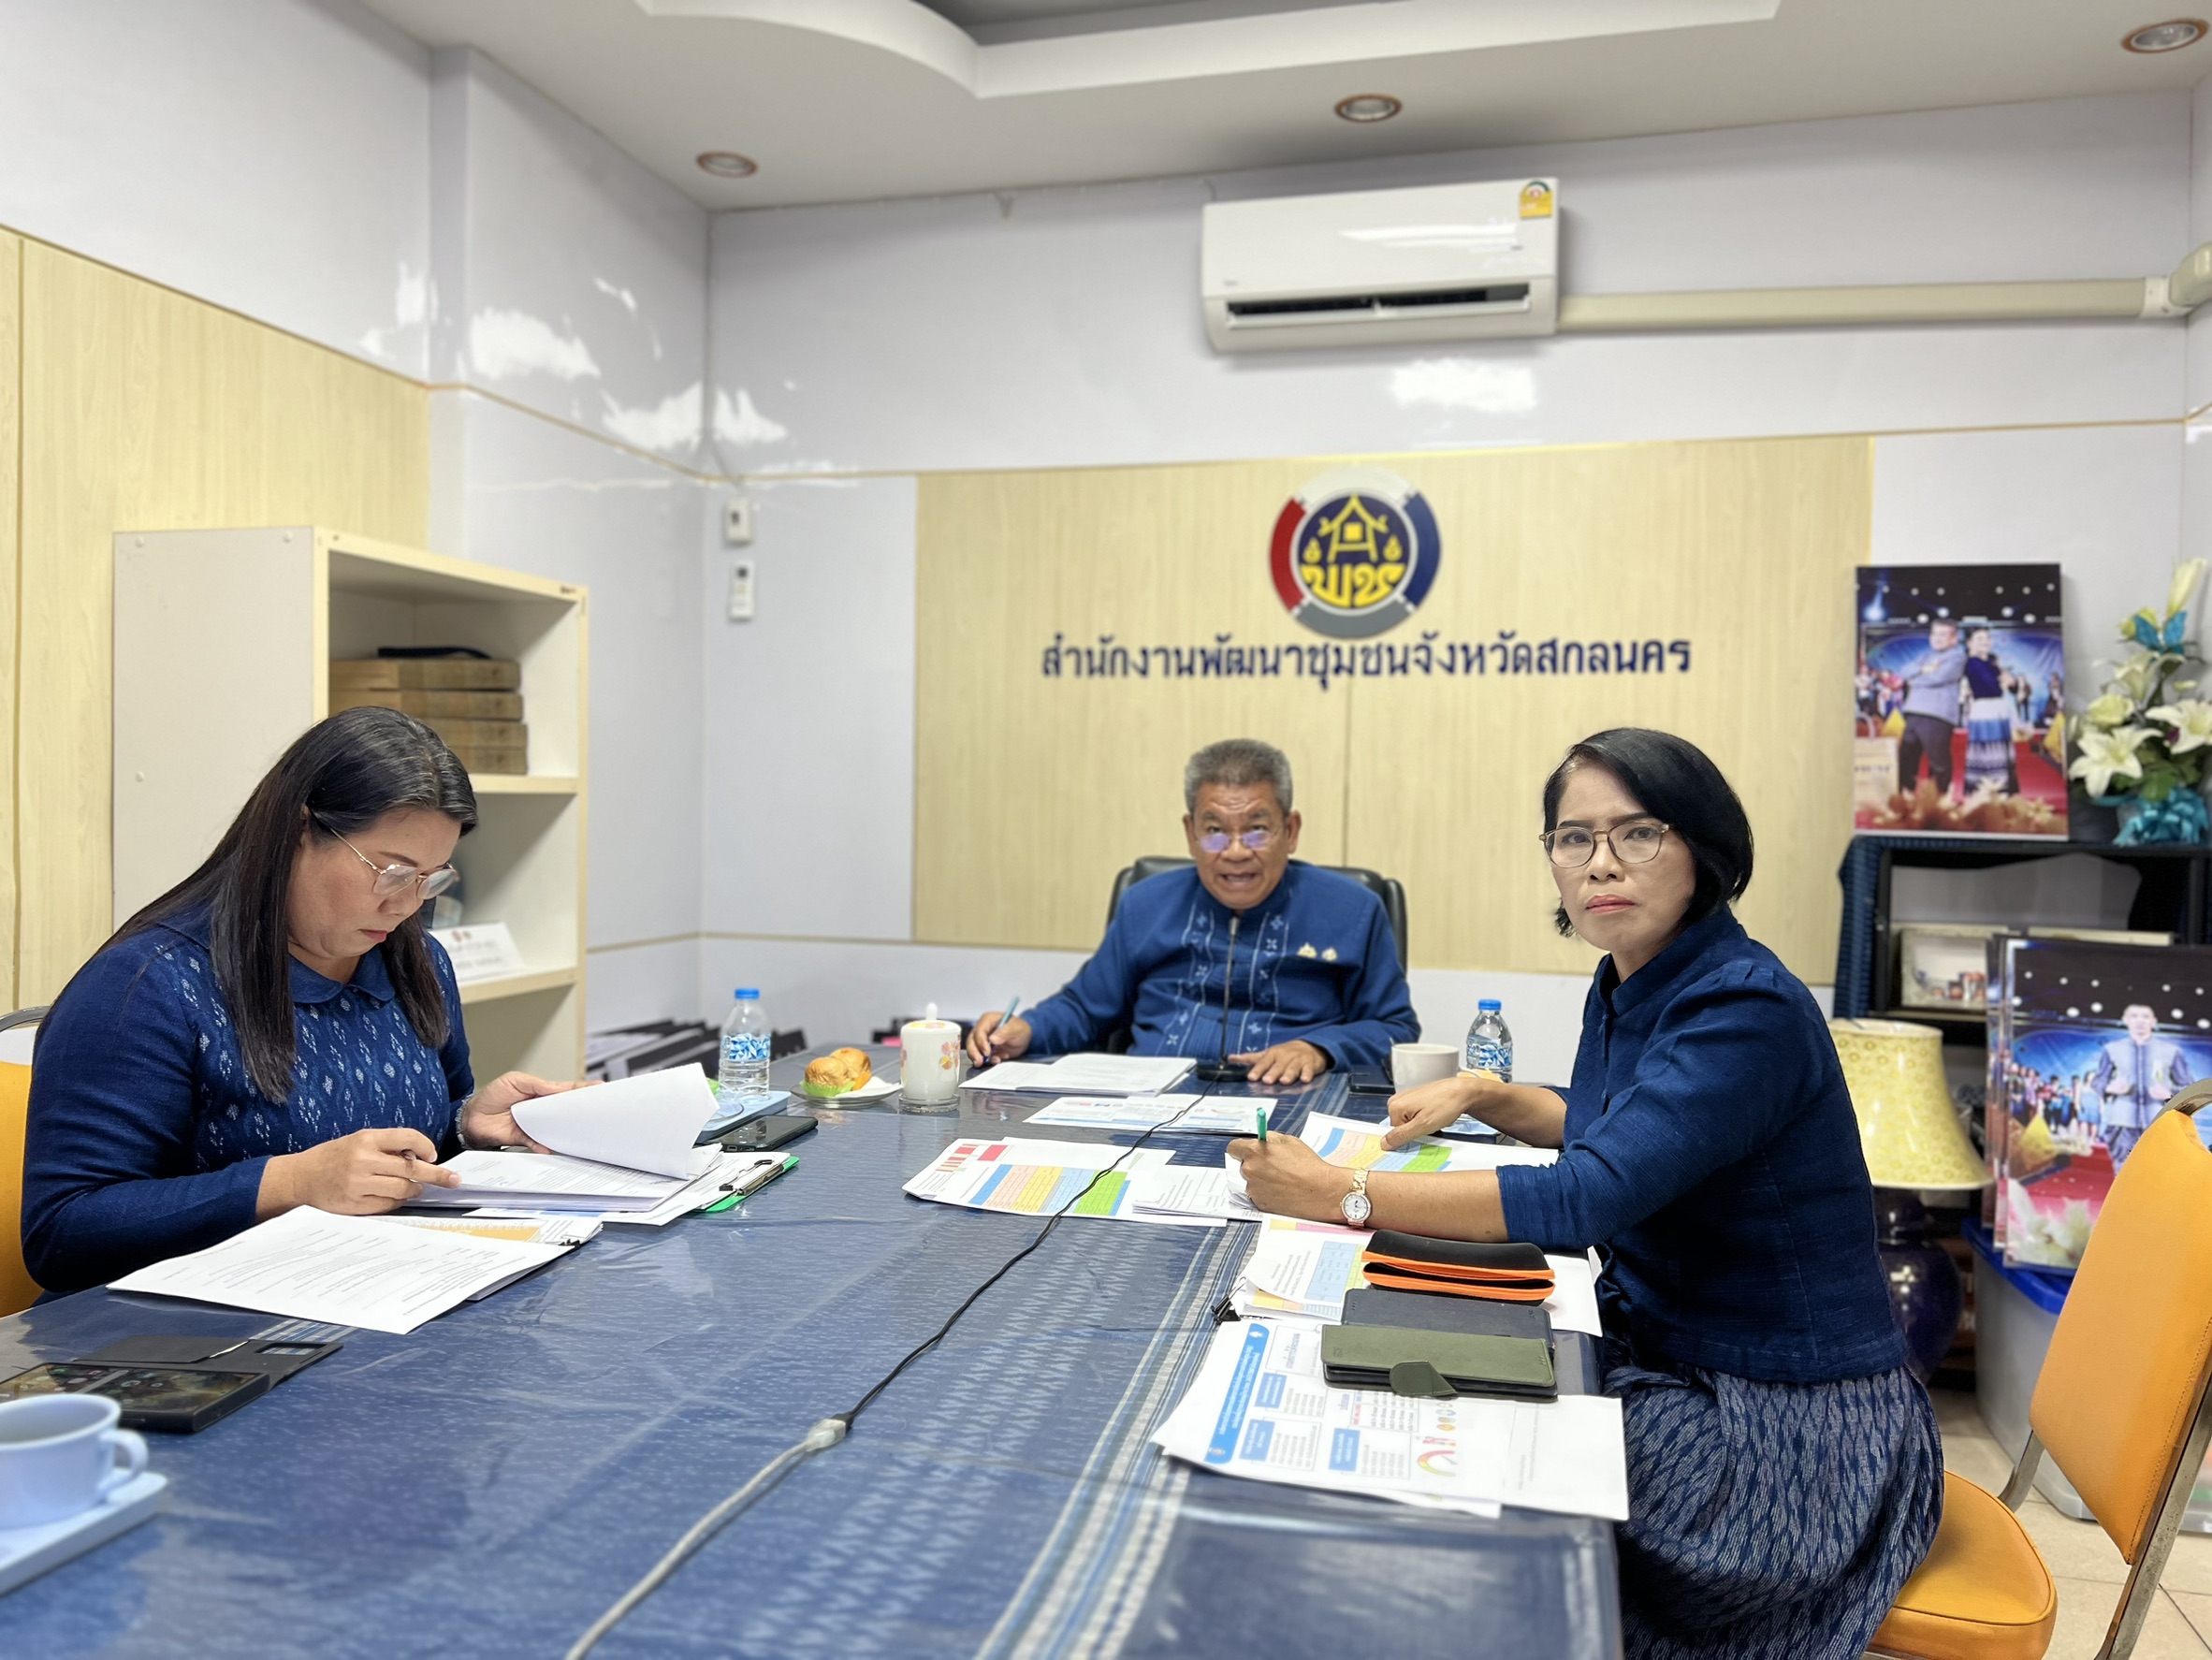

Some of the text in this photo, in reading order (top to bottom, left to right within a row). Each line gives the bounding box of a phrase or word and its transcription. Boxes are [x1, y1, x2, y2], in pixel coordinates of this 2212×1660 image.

[1041, 631, 1691, 691] สำนักงานพัฒนาชุมชนจังหวัดสกลนคร
